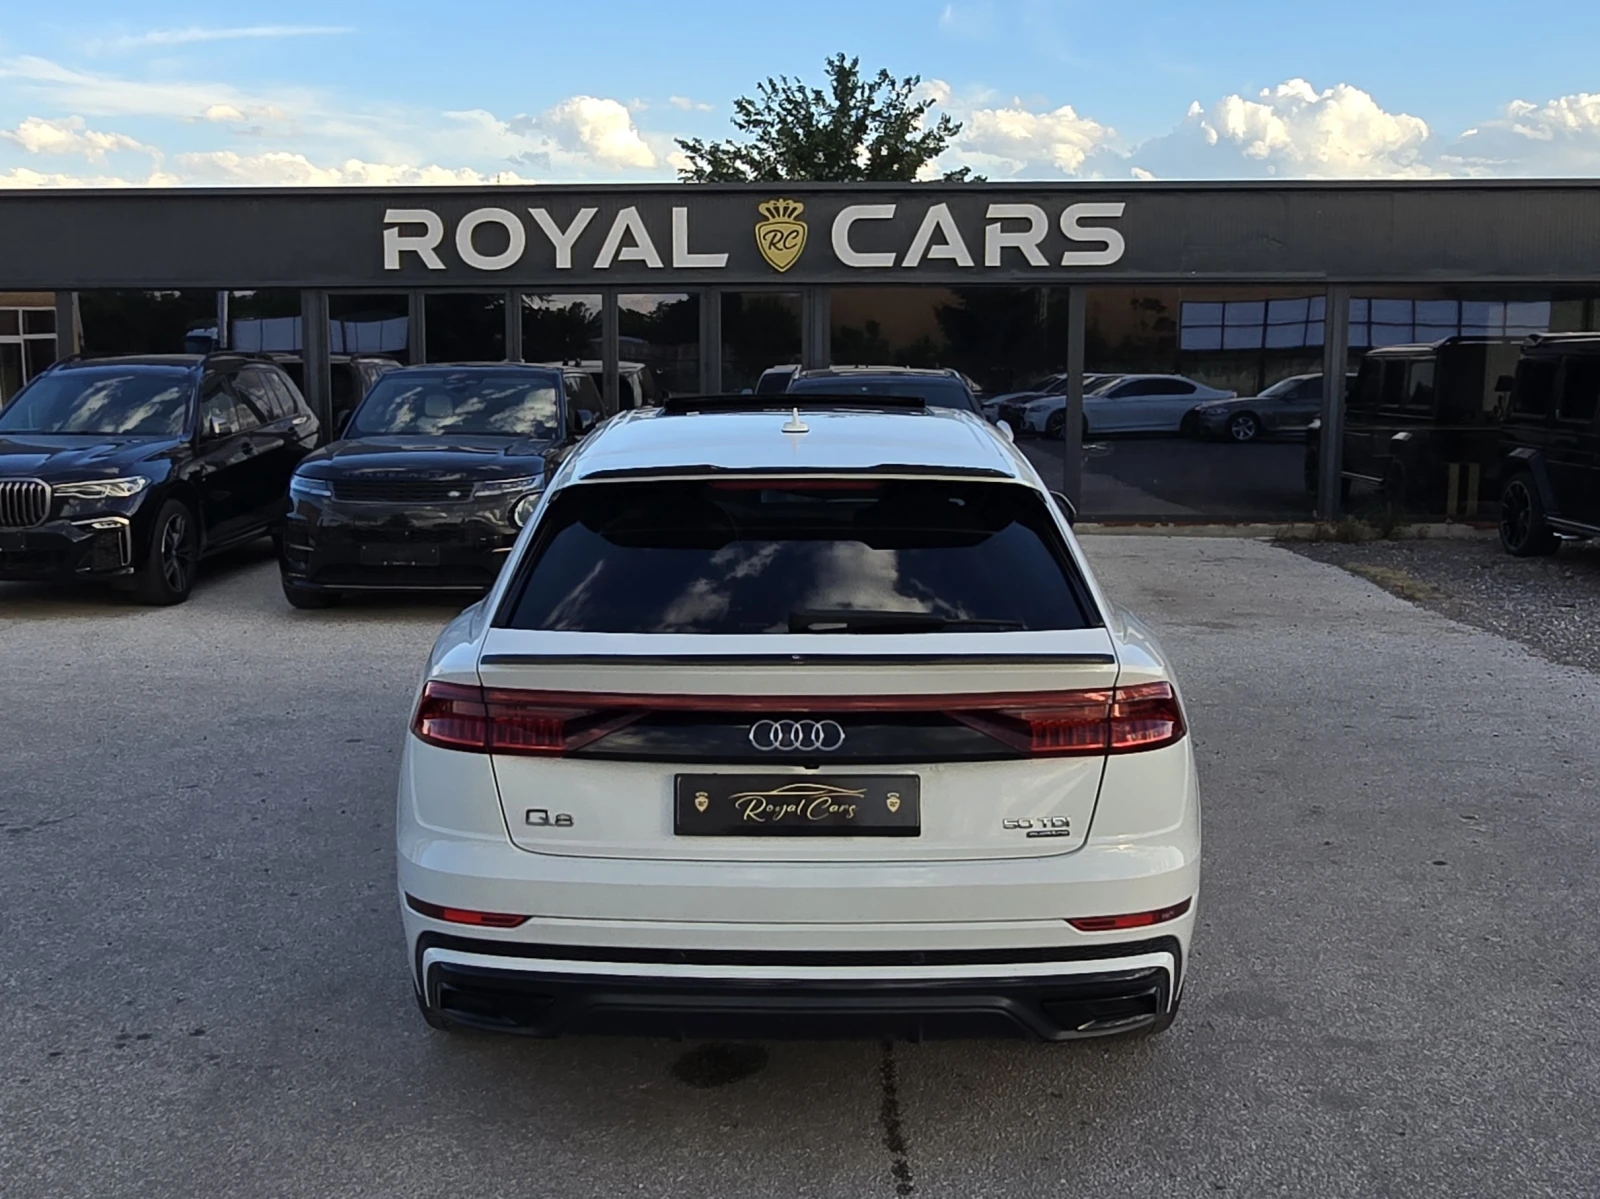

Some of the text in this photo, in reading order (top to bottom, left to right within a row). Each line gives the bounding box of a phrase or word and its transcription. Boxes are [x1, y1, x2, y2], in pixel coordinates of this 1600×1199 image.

[383, 202, 1126, 270] ROYAL CARS
[763, 229, 800, 251] RC
[525, 809, 574, 828] Q8
[735, 796, 857, 822] Royal Cars
